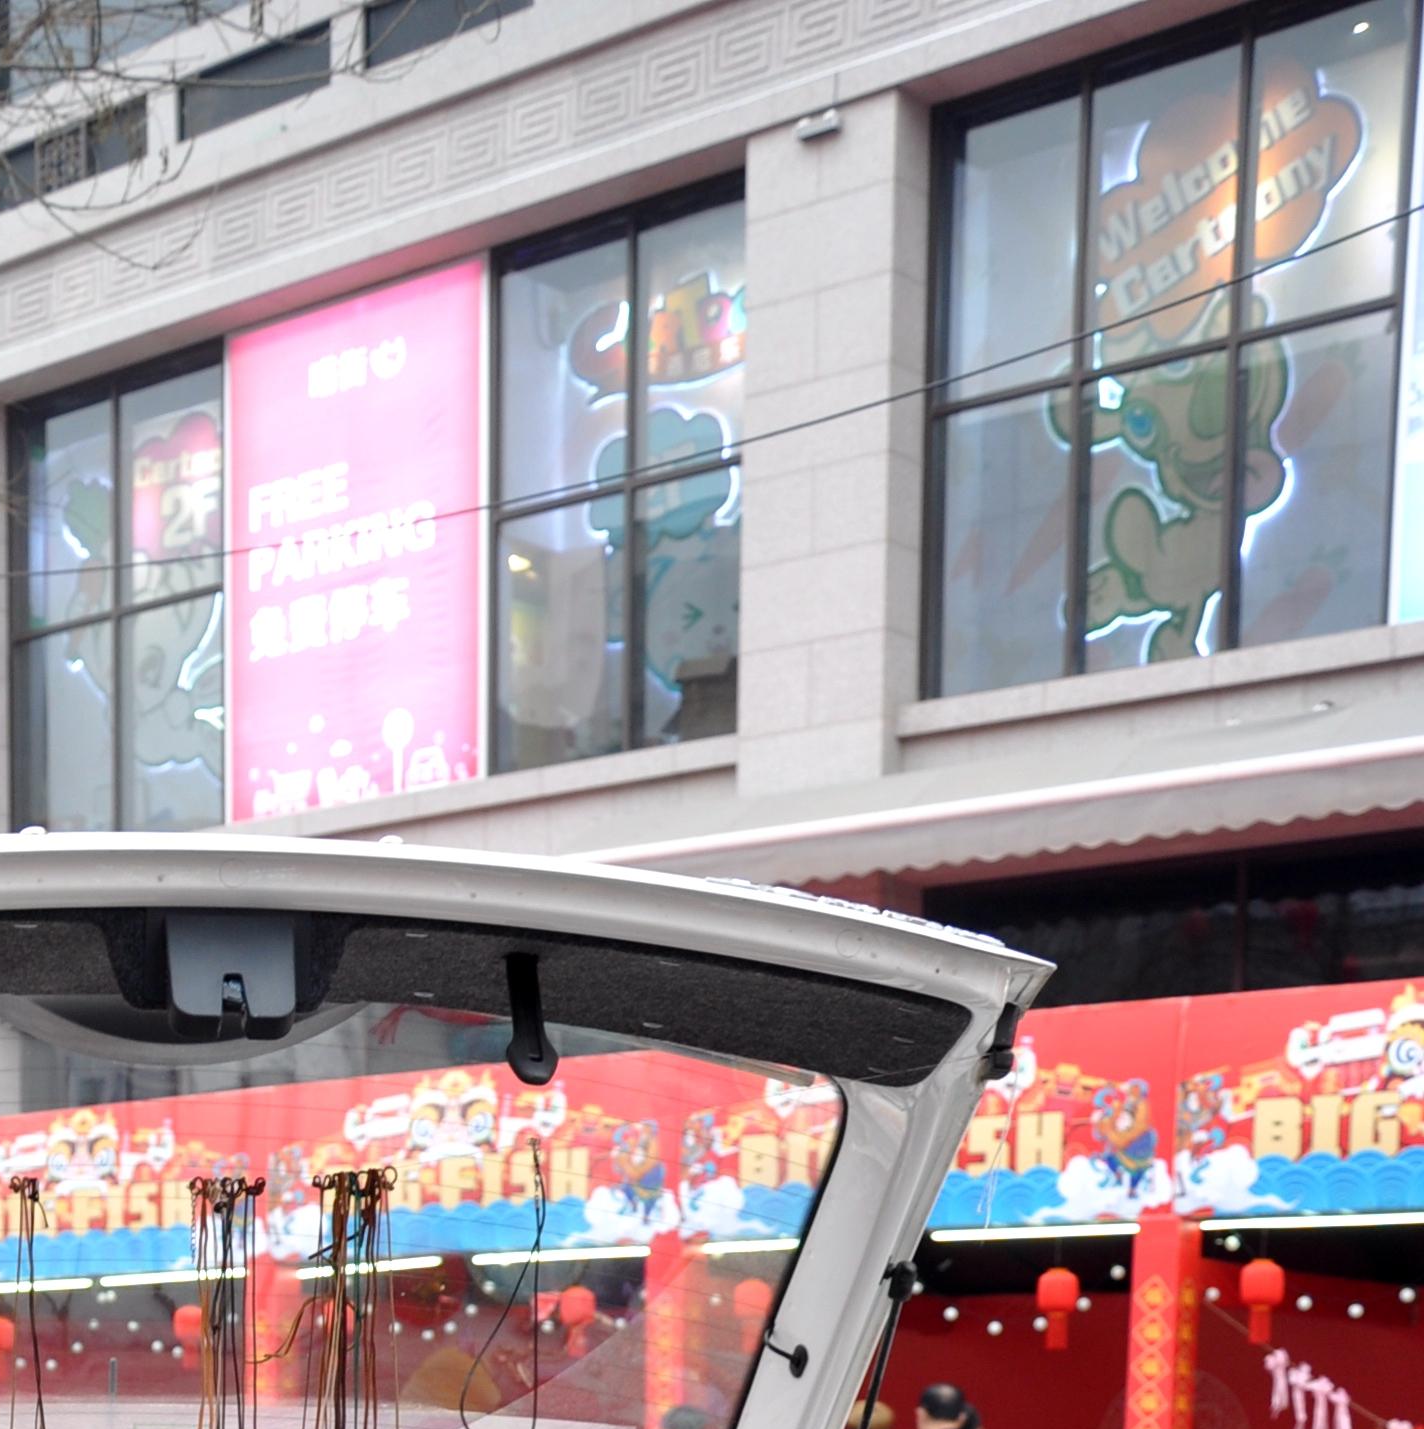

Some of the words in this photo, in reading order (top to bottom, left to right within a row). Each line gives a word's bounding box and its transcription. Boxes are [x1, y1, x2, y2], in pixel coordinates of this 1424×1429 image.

[247, 461, 350, 534] FREE
[248, 499, 437, 593] PARKING
[1252, 1091, 1402, 1160] BIG
[442, 1147, 589, 1210] FISH
